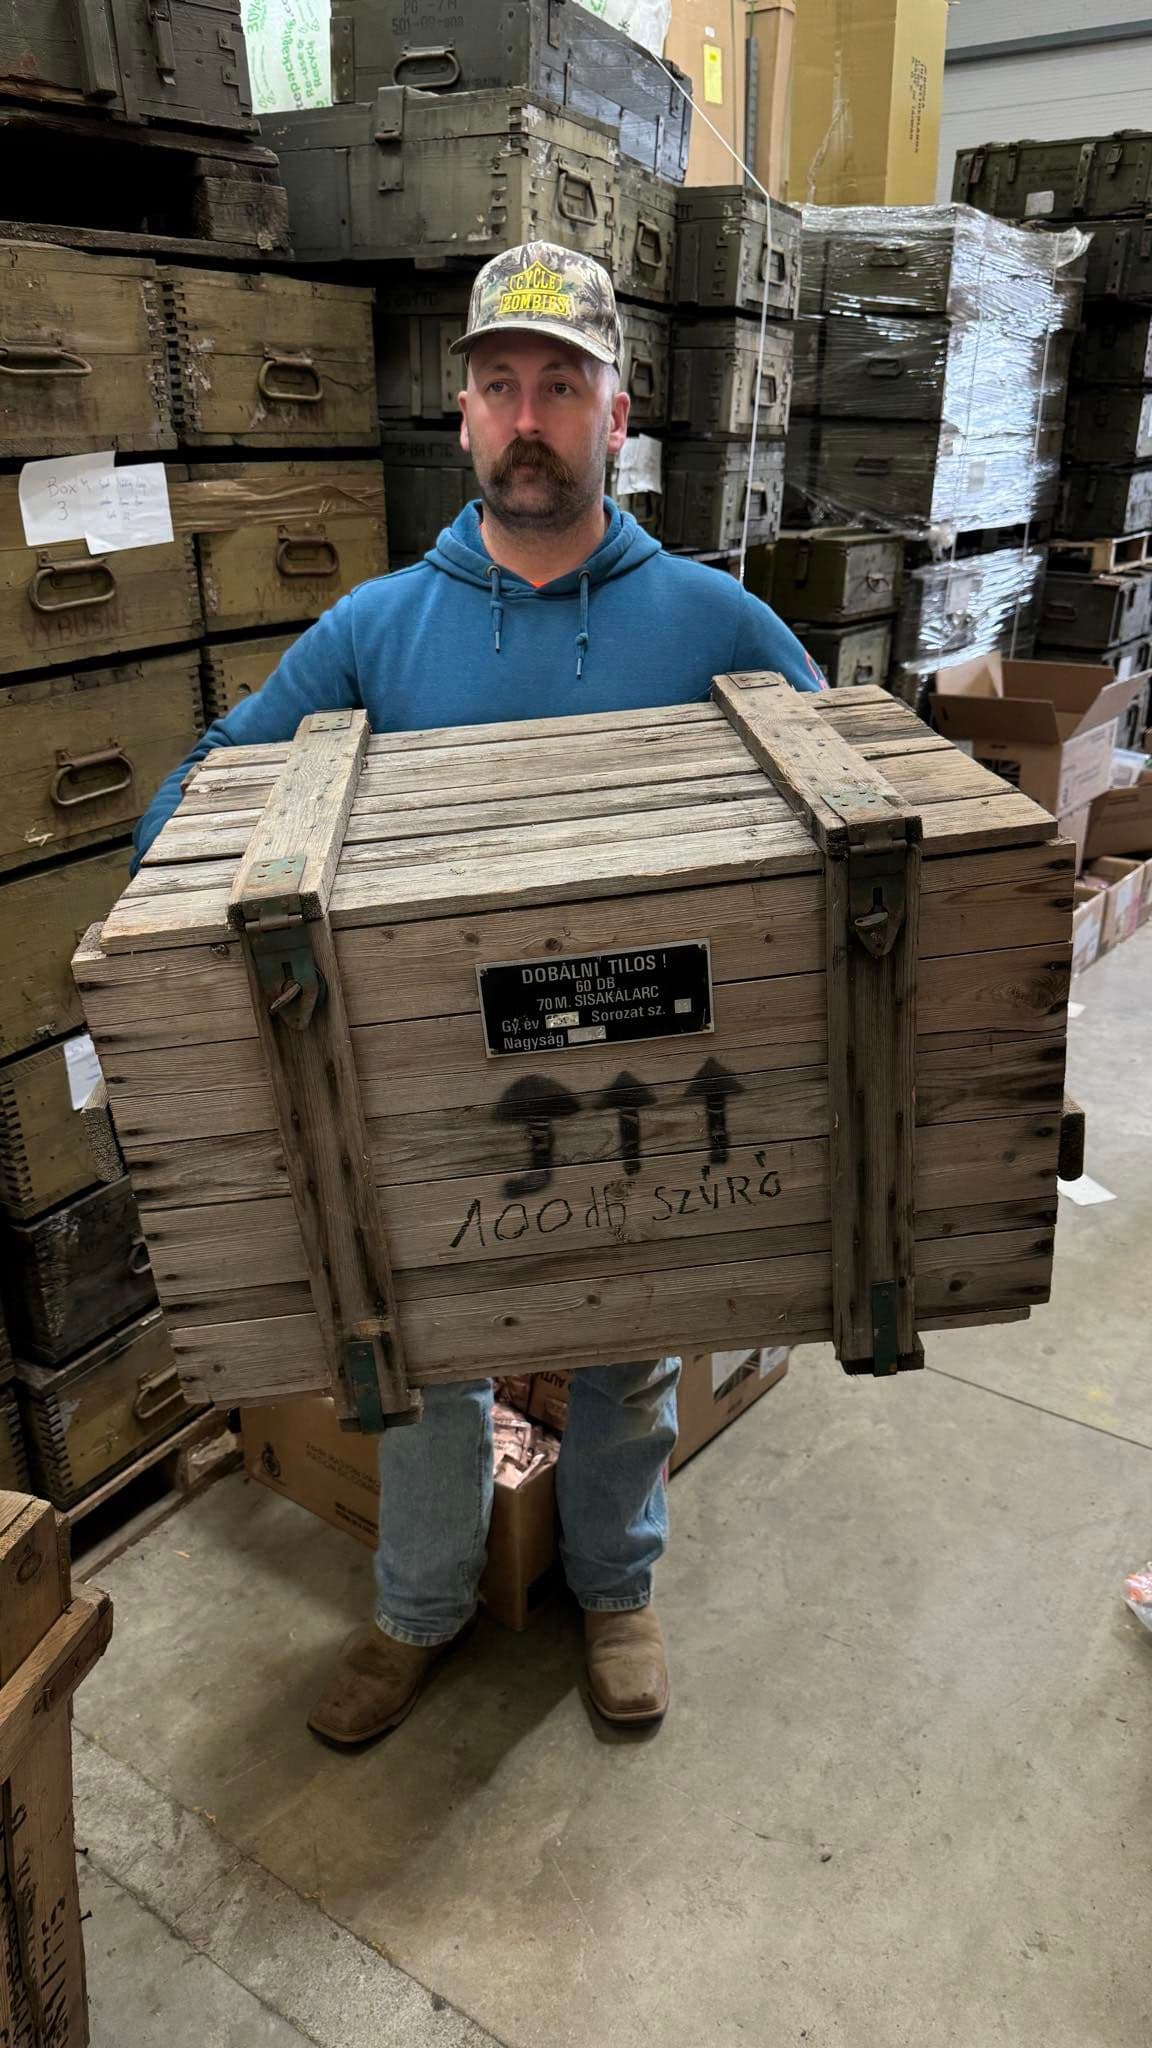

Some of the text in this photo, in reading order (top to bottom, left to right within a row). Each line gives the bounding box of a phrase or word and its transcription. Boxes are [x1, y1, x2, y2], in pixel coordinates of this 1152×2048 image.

[515, 267, 556, 291] CYCLE
[503, 294, 567, 314] ZOMBIES
[47, 476, 78, 497] Box
[57, 501, 69, 521] 3
[522, 962, 600, 984] DOBÁLNI
[608, 955, 657, 975] TILOS
[576, 977, 615, 993] 60 DB
[591, 1006, 644, 1023] Sorozat
[647, 1005, 666, 1017] sz.
[503, 1032, 564, 1051] Nagyság
